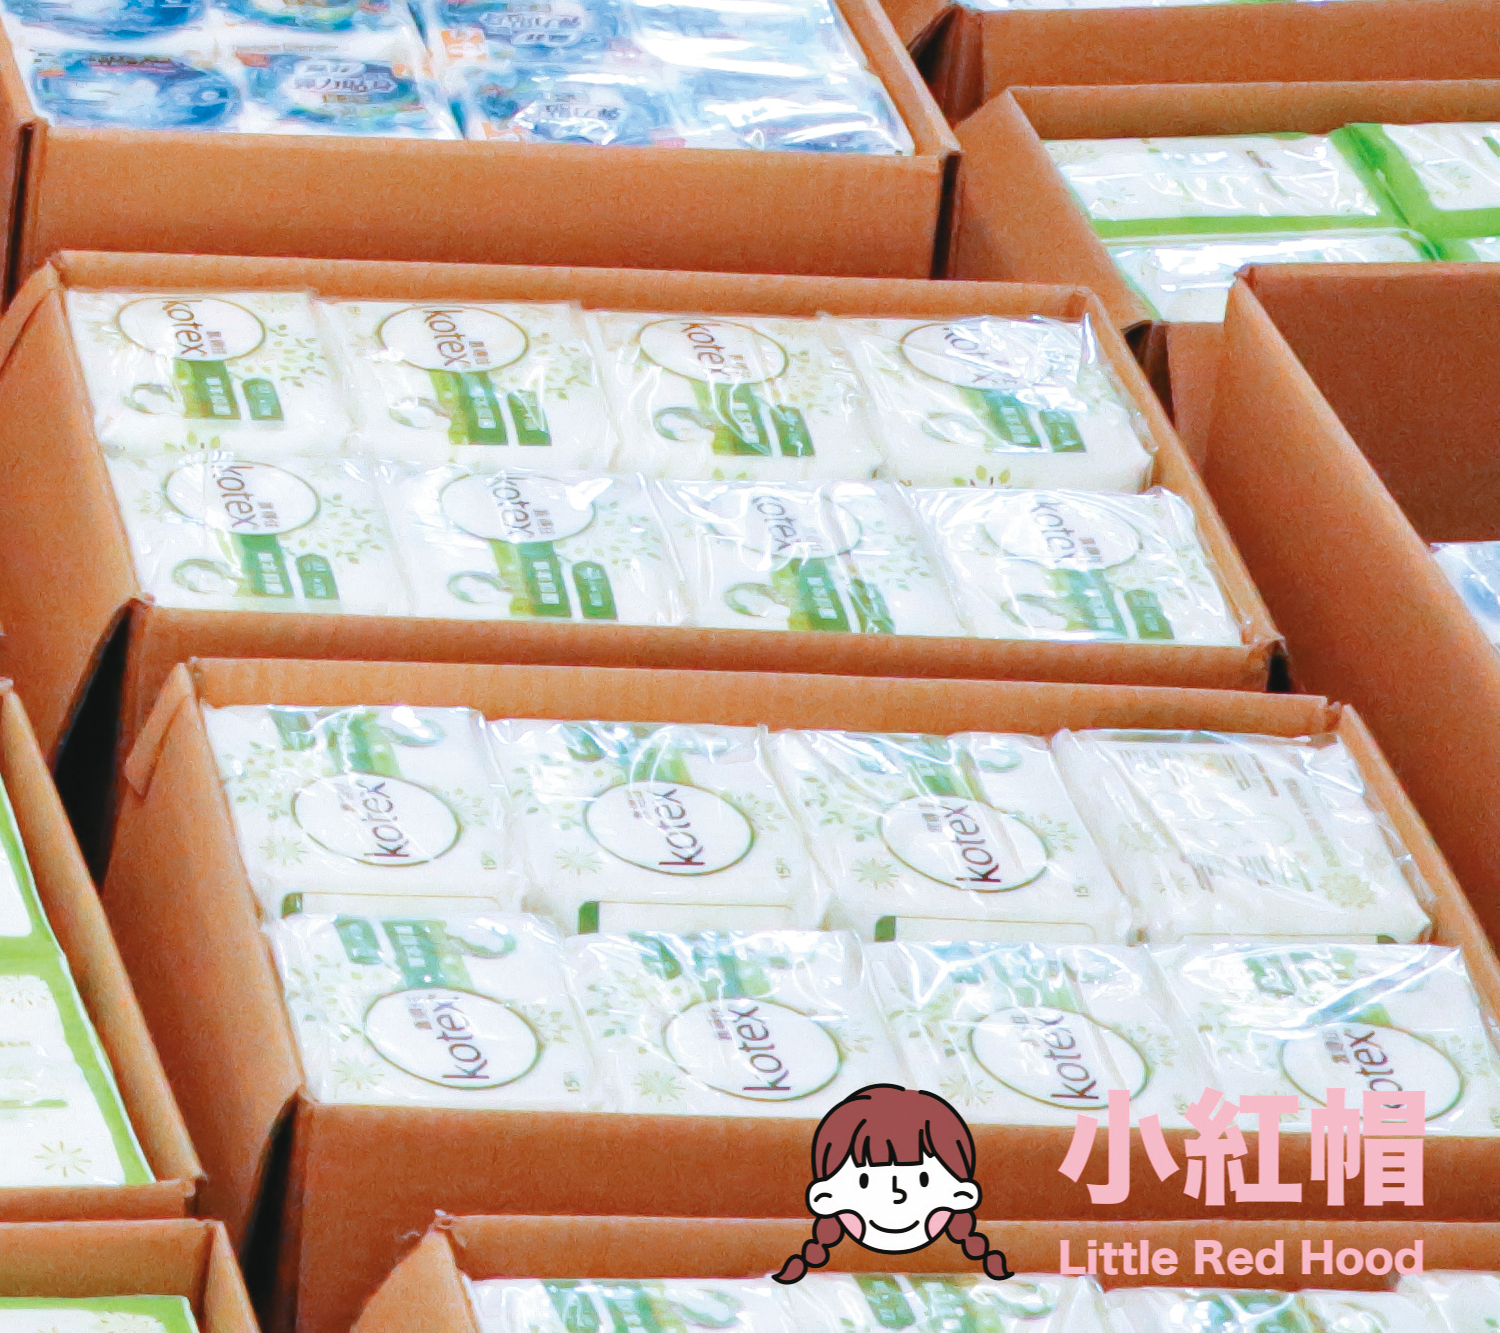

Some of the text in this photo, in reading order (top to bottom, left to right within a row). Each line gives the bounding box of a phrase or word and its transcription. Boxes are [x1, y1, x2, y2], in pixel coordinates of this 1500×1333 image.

[162, 299, 208, 357] kotex
[424, 309, 474, 368] kotex
[217, 464, 259, 530] kotex
[363, 781, 410, 859] kotex
[658, 787, 706, 867] kotex
[955, 803, 1001, 885] kotex
[442, 997, 491, 1081] kotex
[742, 1005, 791, 1092] kotex
[1037, 1012, 1100, 1101] kotex
